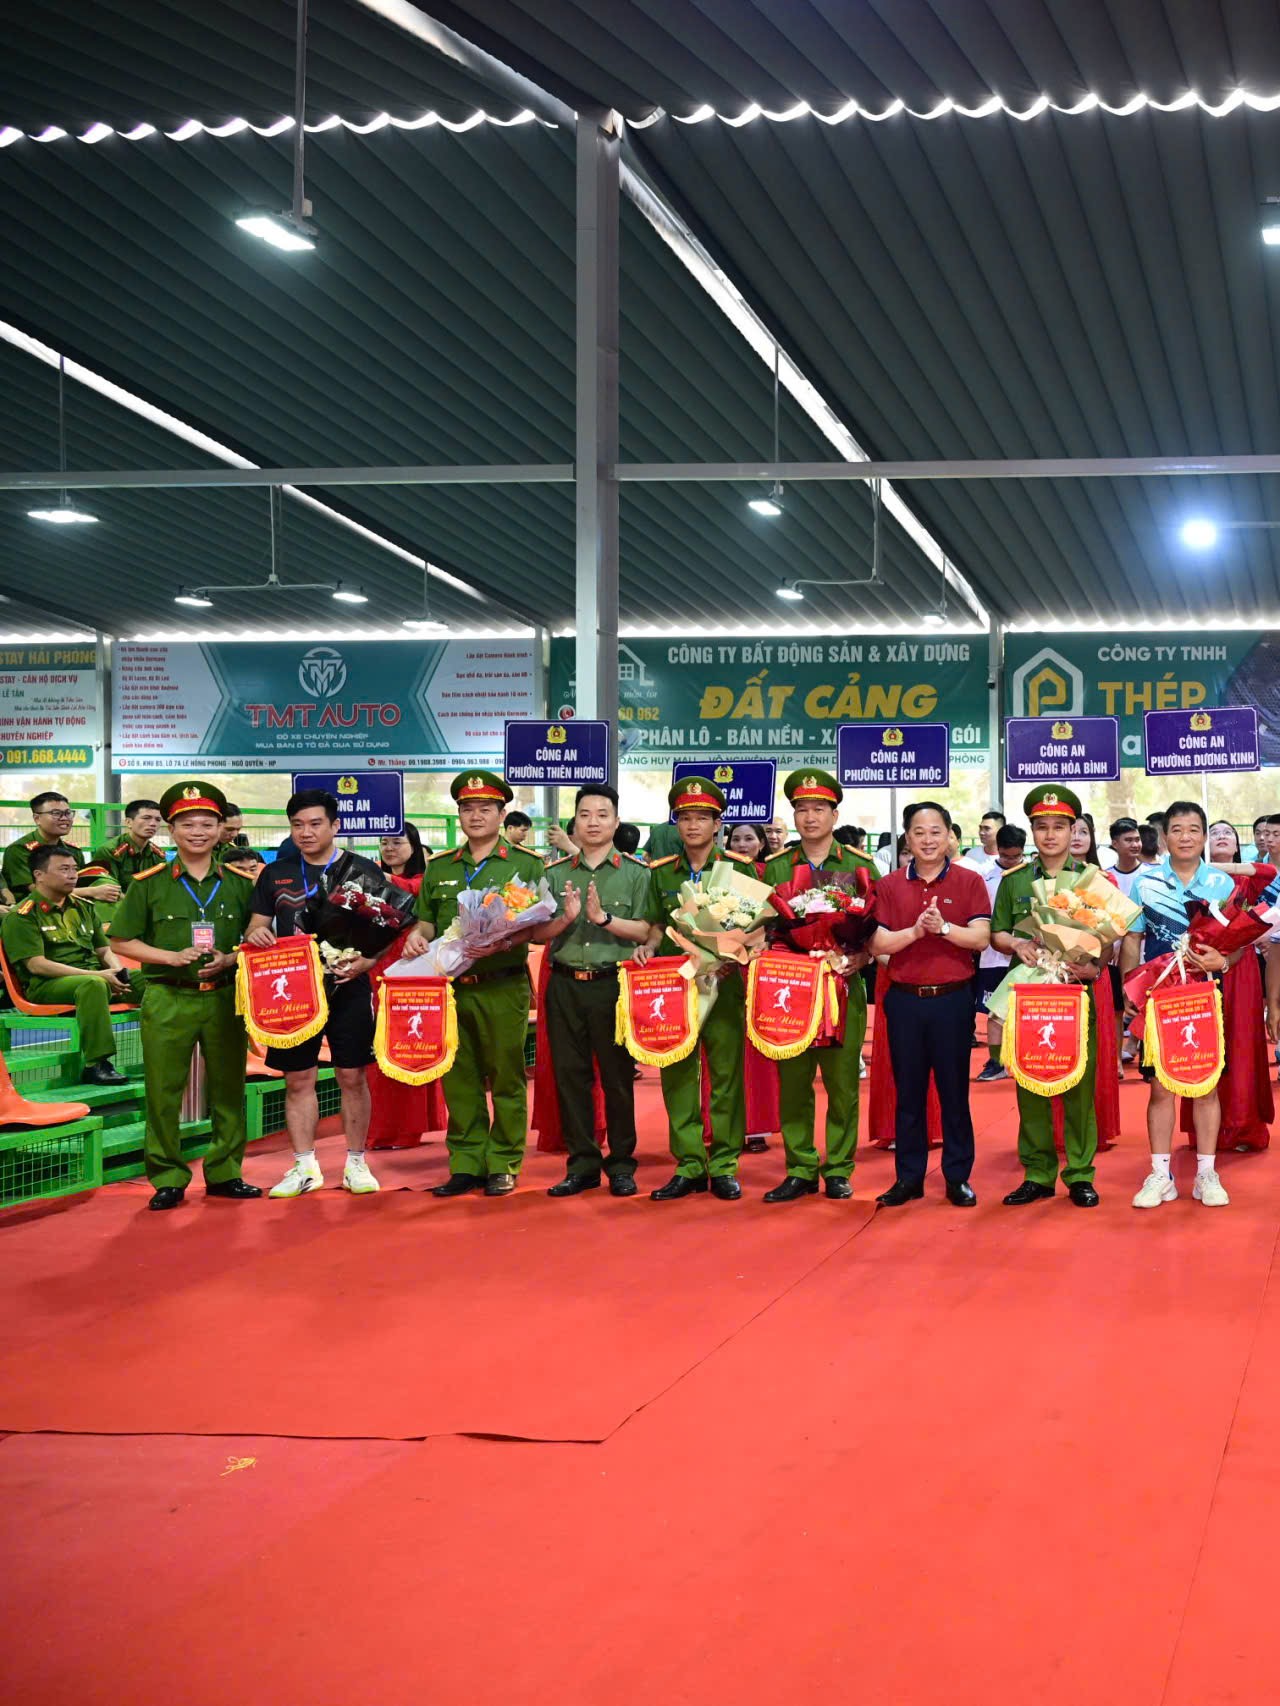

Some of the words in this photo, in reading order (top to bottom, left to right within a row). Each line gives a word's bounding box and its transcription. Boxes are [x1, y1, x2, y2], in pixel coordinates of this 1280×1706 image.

[667, 643, 713, 664] CÔNG
[717, 646, 739, 664] TY
[742, 639, 773, 664] BẤT
[777, 643, 823, 667] ĐỘNG
[828, 639, 863, 664] SẢN
[868, 645, 880, 663] &
[886, 642, 920, 663] XÂY
[923, 643, 970, 665] DỰNG
[1097, 643, 1151, 662] CÔNG
[1154, 646, 1177, 661] TY
[1180, 646, 1227, 661] TNHH
[68, 675, 78, 685] VỤ
[699, 668, 796, 720] ĐẤT
[803, 672, 939, 719] CẢNG
[1097, 672, 1207, 716] THÉP
[244, 703, 317, 728] TMT
[317, 703, 401, 728] AUTO
[639, 726, 687, 746] PHÂN
[689, 725, 710, 746] LÔ
[727, 725, 762, 746] BÁN
[951, 723, 981, 745] GÓI
[1178, 734, 1208, 750] CÔNG
[1210, 735, 1225, 748] AN
[6, 749, 87, 763] 091.668.4444
[535, 747, 562, 762] CÔNG
[563, 749, 577, 762] AN
[870, 749, 898, 764] CÔNG
[901, 751, 915, 763] AN
[1039, 743, 1069, 758] CÔNG
[1071, 744, 1085, 757] AN
[231, 759, 244, 767] NGÔ
[650, 757, 671, 765] HUY
[803, 754, 832, 765] KÊNH
[1017, 761, 1058, 775] PHƯỜNG
[1060, 759, 1080, 774] HÒA
[1083, 759, 1107, 774] BÌNH
[1150, 753, 1192, 769] PHƯỜNG
[1194, 752, 1229, 766] DƯƠNG
[1231, 751, 1255, 765] KINH
[508, 765, 545, 780] PHƯỜNG
[546, 764, 571, 779] THIÊN
[573, 765, 604, 780] HƯƠNG
[844, 766, 884, 782] PHƯỜNG
[886, 765, 898, 781] LÊ
[900, 765, 916, 781] ÍCH
[919, 765, 942, 783] MỘC
[729, 788, 744, 800] AN
[356, 799, 371, 812] AN
[741, 800, 767, 817] ĐẰNG
[343, 817, 366, 830] NAM
[368, 814, 396, 832] TRIỆU
